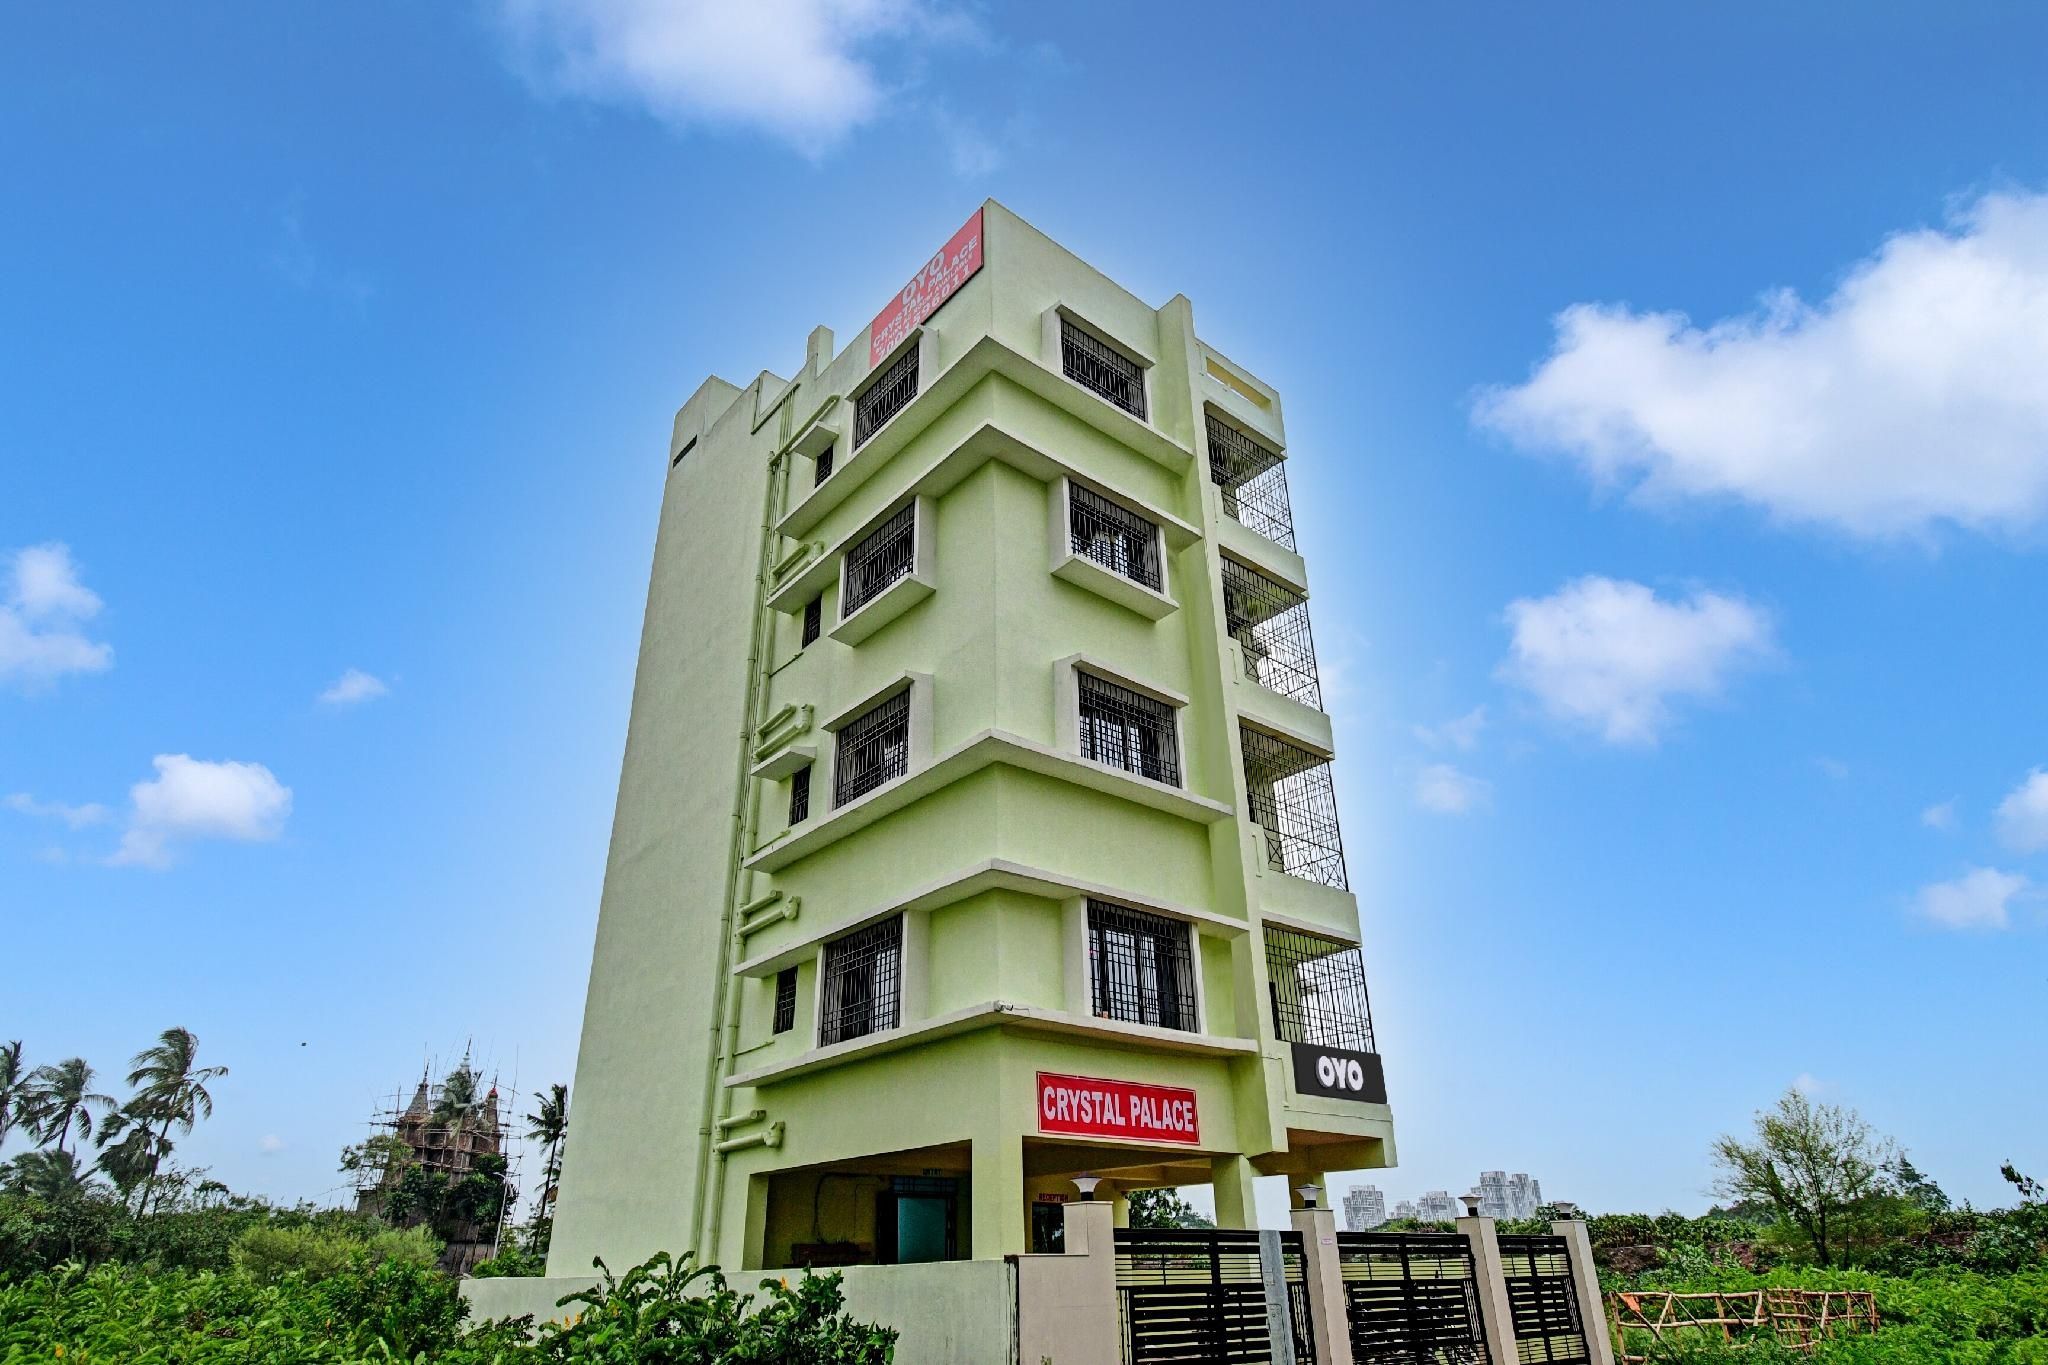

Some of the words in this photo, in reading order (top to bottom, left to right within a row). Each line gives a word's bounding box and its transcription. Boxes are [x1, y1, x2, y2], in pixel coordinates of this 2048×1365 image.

[873, 291, 925, 348] CRYSTAL
[928, 235, 977, 292] PALACE
[902, 251, 945, 305] OYO
[1316, 1055, 1364, 1091] OYO
[1043, 1086, 1126, 1126] CRYSTAL
[1130, 1095, 1195, 1133] PALACE
